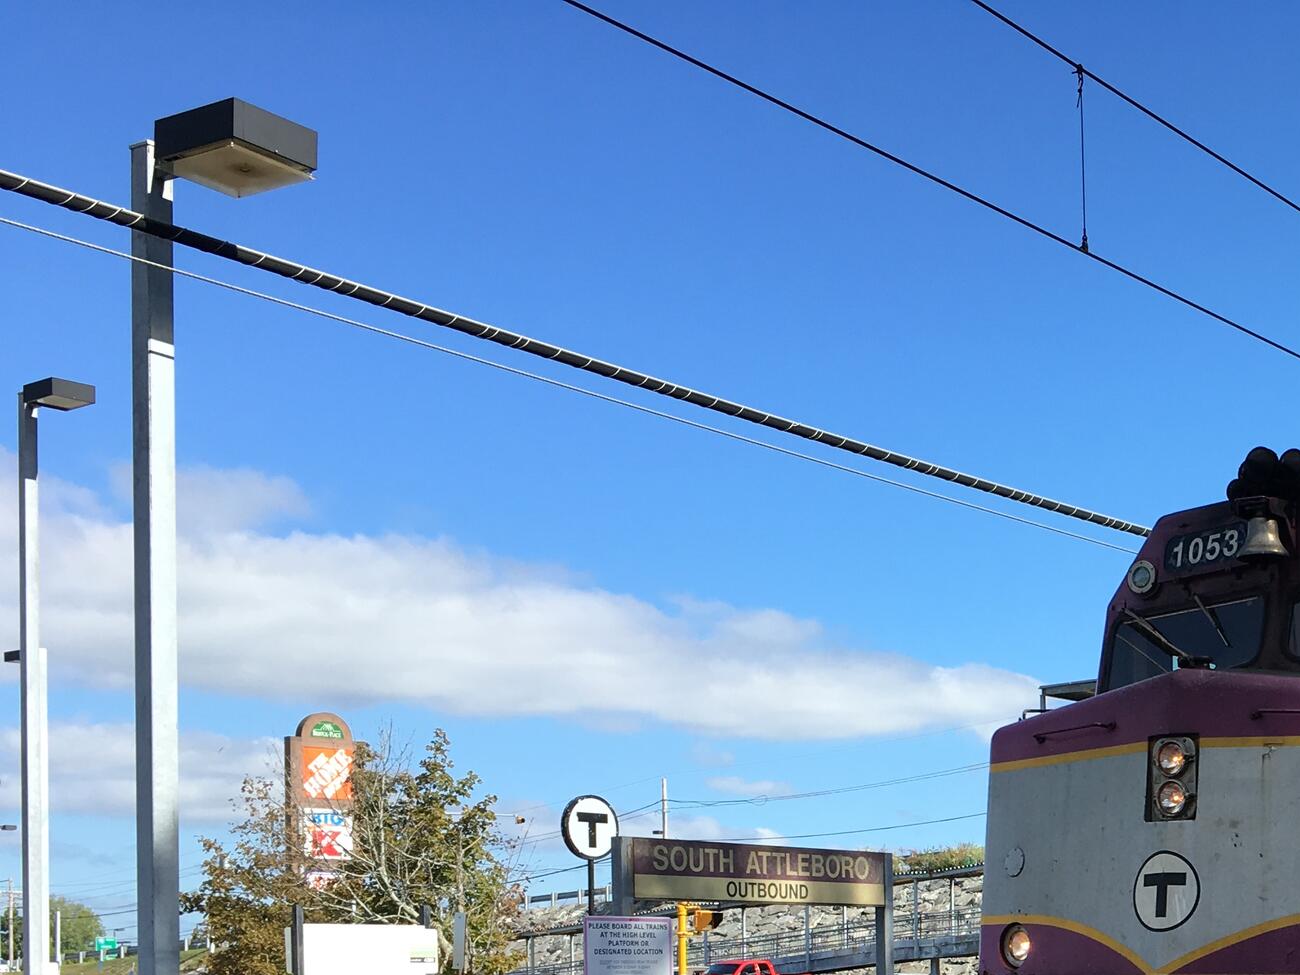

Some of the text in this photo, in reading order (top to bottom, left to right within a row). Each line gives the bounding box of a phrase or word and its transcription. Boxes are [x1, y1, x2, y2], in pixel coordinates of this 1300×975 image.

[1172, 529, 1239, 567] 1053
[303, 748, 352, 799] HOME
[312, 830, 342, 857] K
[576, 811, 608, 848] T
[652, 844, 870, 881] SOUTH ATTLEBORO
[726, 880, 809, 900] OUTBOUND
[1143, 872, 1187, 918] T
[594, 948, 663, 956] DESIGNATED LOCATION
